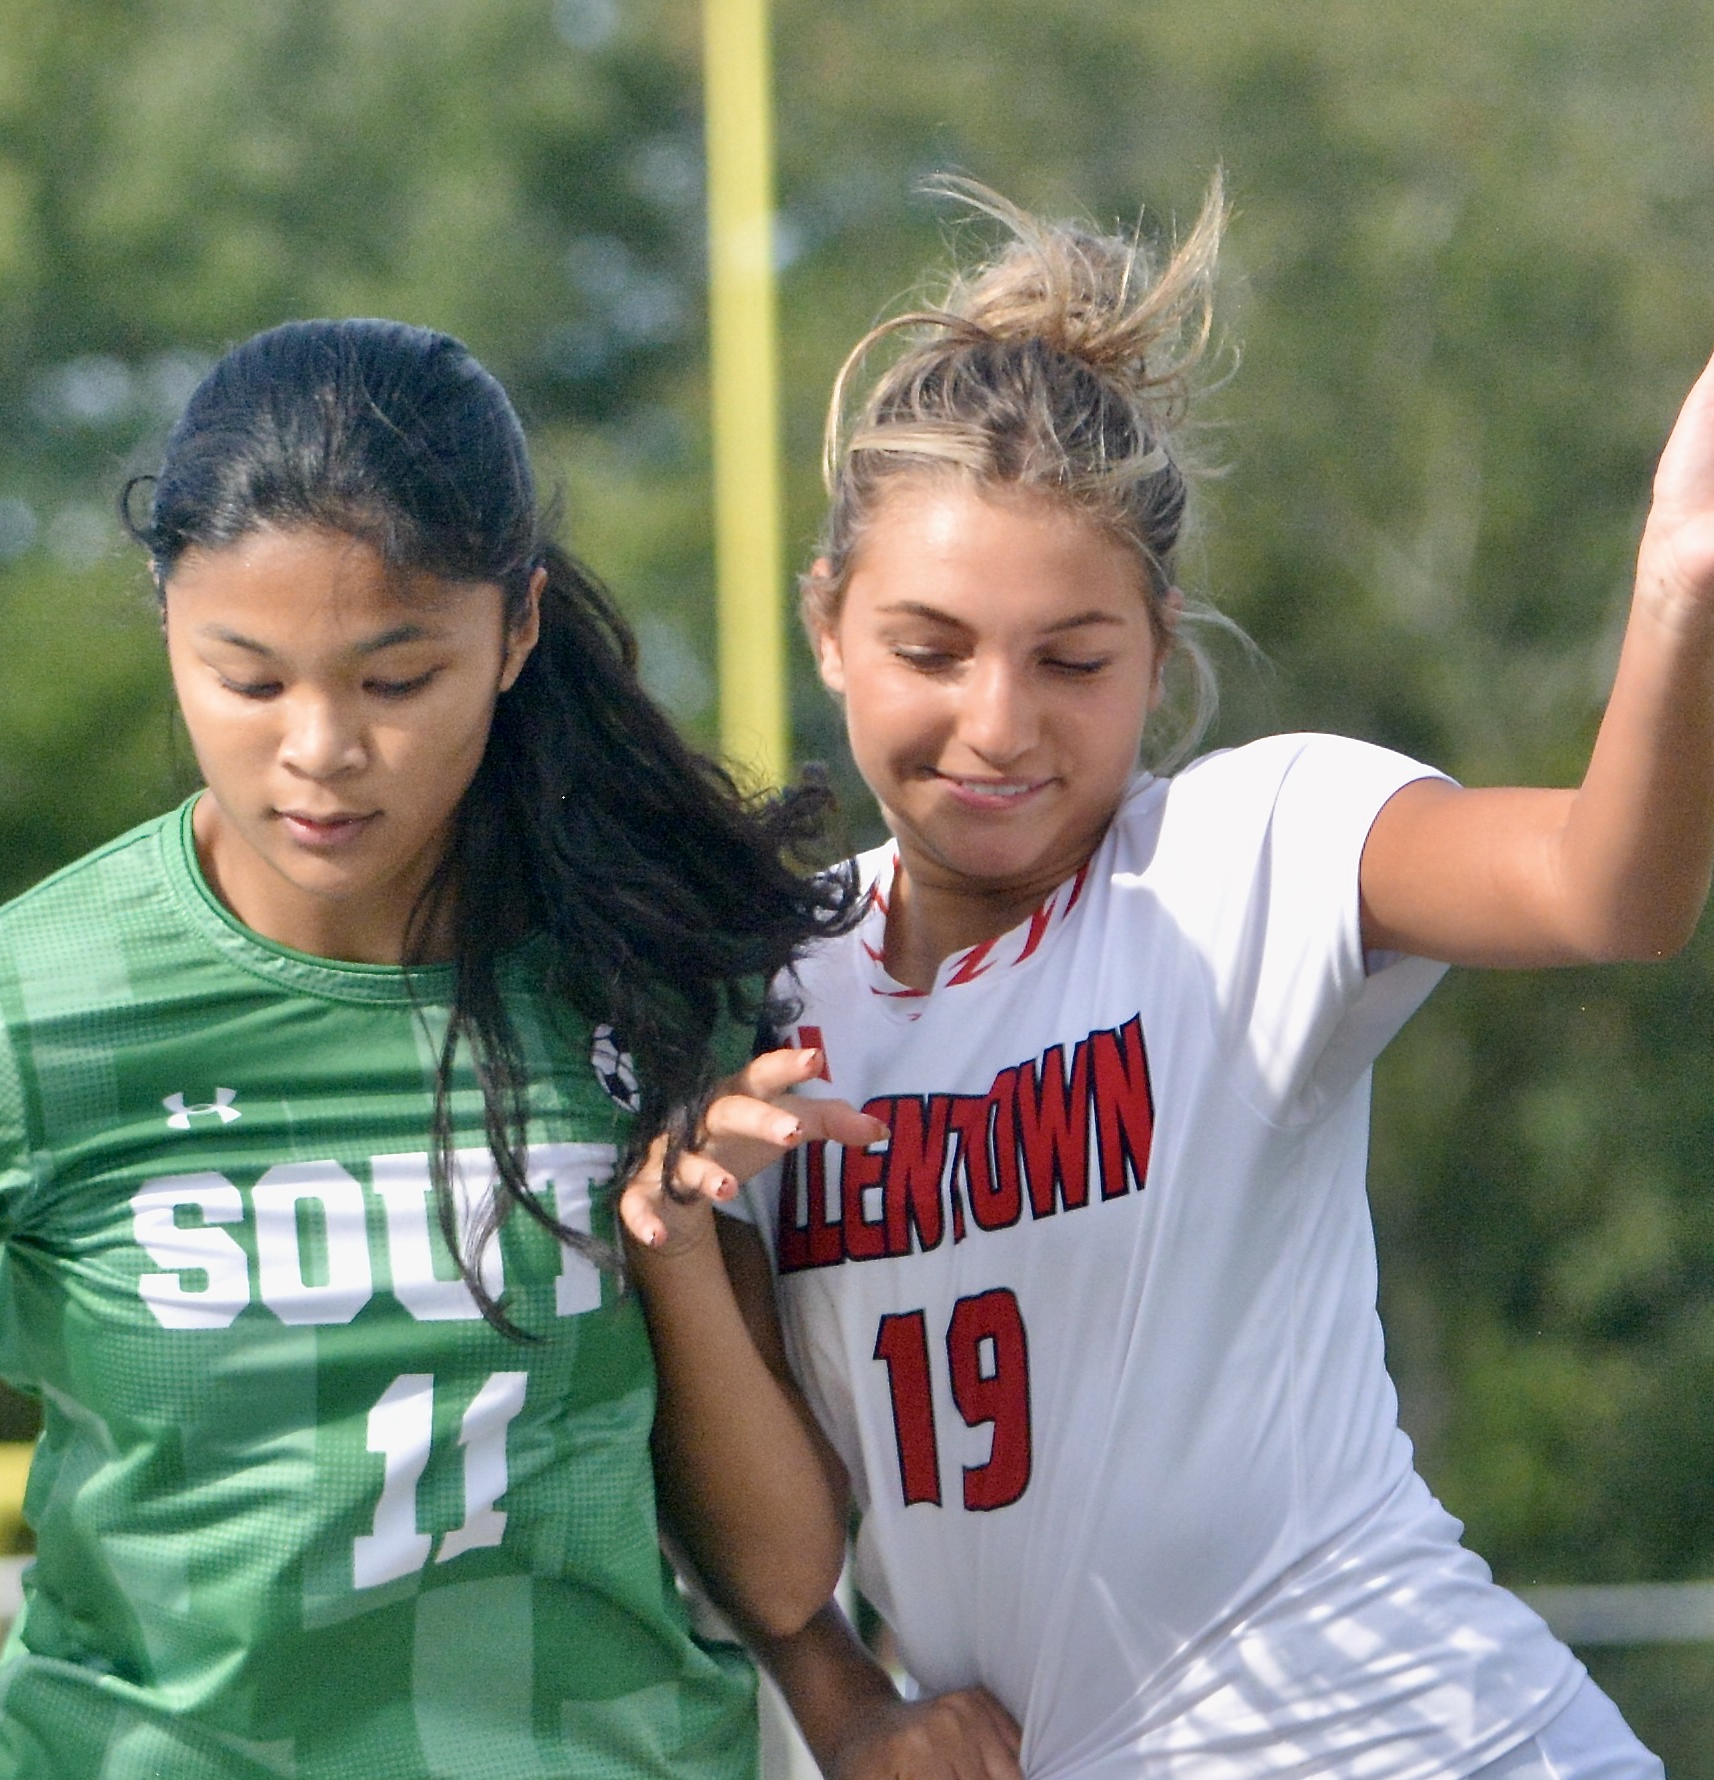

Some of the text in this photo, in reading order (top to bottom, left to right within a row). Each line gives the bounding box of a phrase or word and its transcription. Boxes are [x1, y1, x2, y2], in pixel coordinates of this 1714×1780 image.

[129, 1142, 624, 1329] SOUT
[778, 1012, 1155, 1275] LLENTOWN
[354, 1372, 527, 1588] 11
[872, 1287, 1032, 1511] 19
